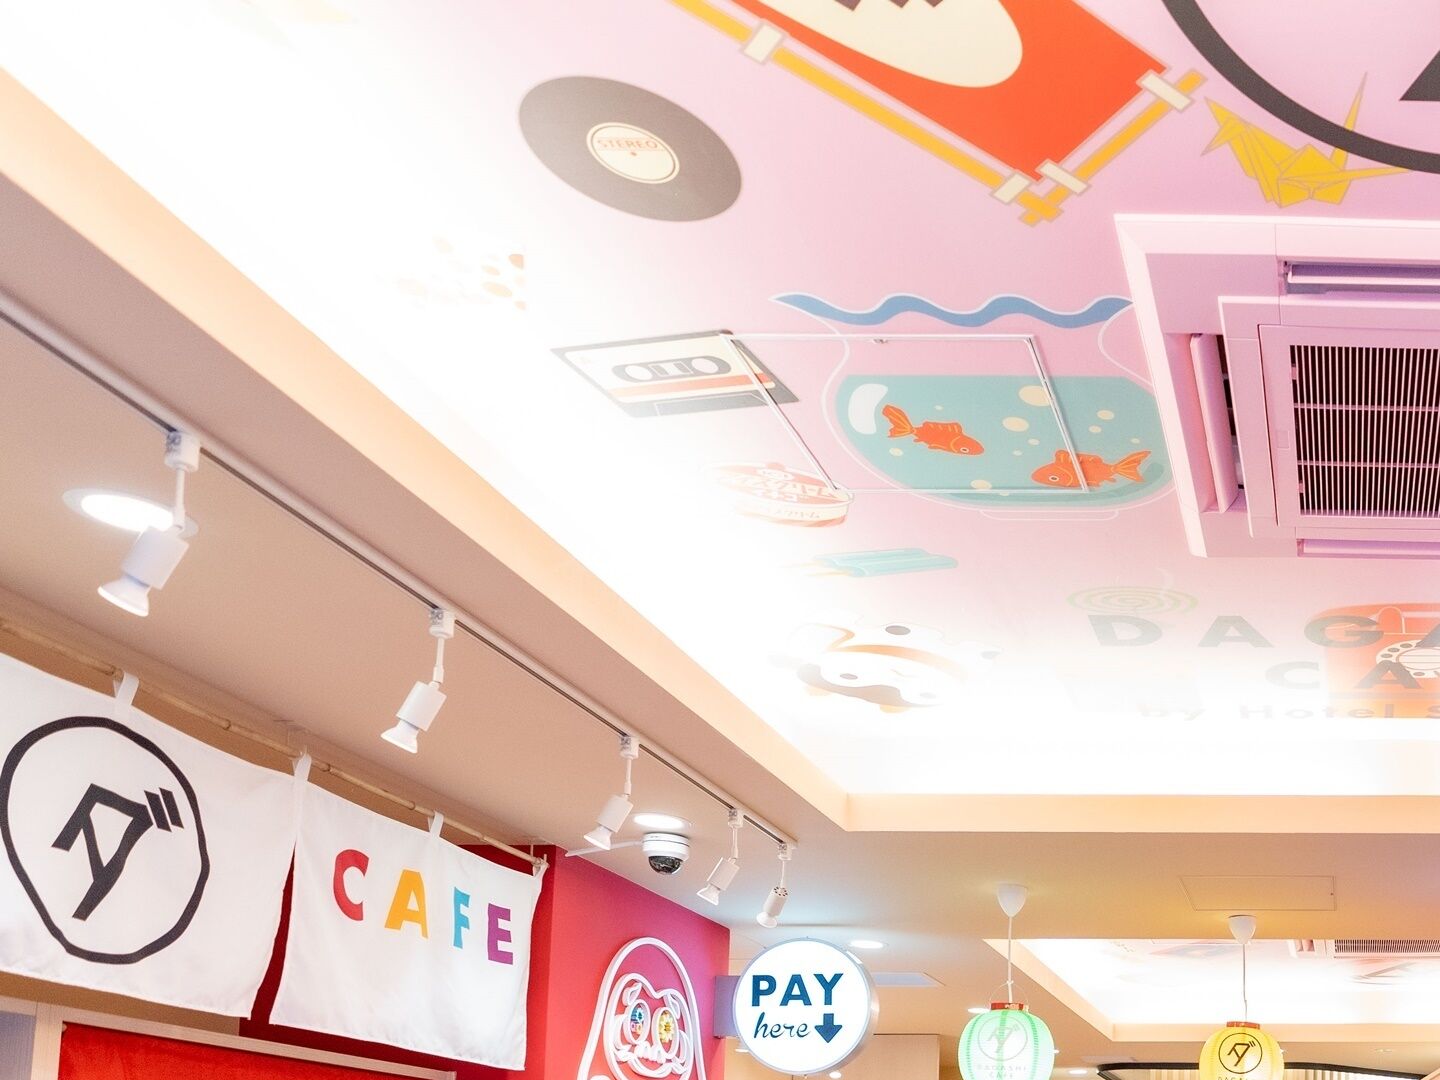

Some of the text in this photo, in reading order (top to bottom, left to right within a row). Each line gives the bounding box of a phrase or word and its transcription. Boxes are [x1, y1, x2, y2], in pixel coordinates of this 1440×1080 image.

[597, 140, 658, 149] STEREO
[333, 849, 514, 965] CAFE
[752, 973, 844, 1007] PAY
[753, 1011, 810, 1039] here
